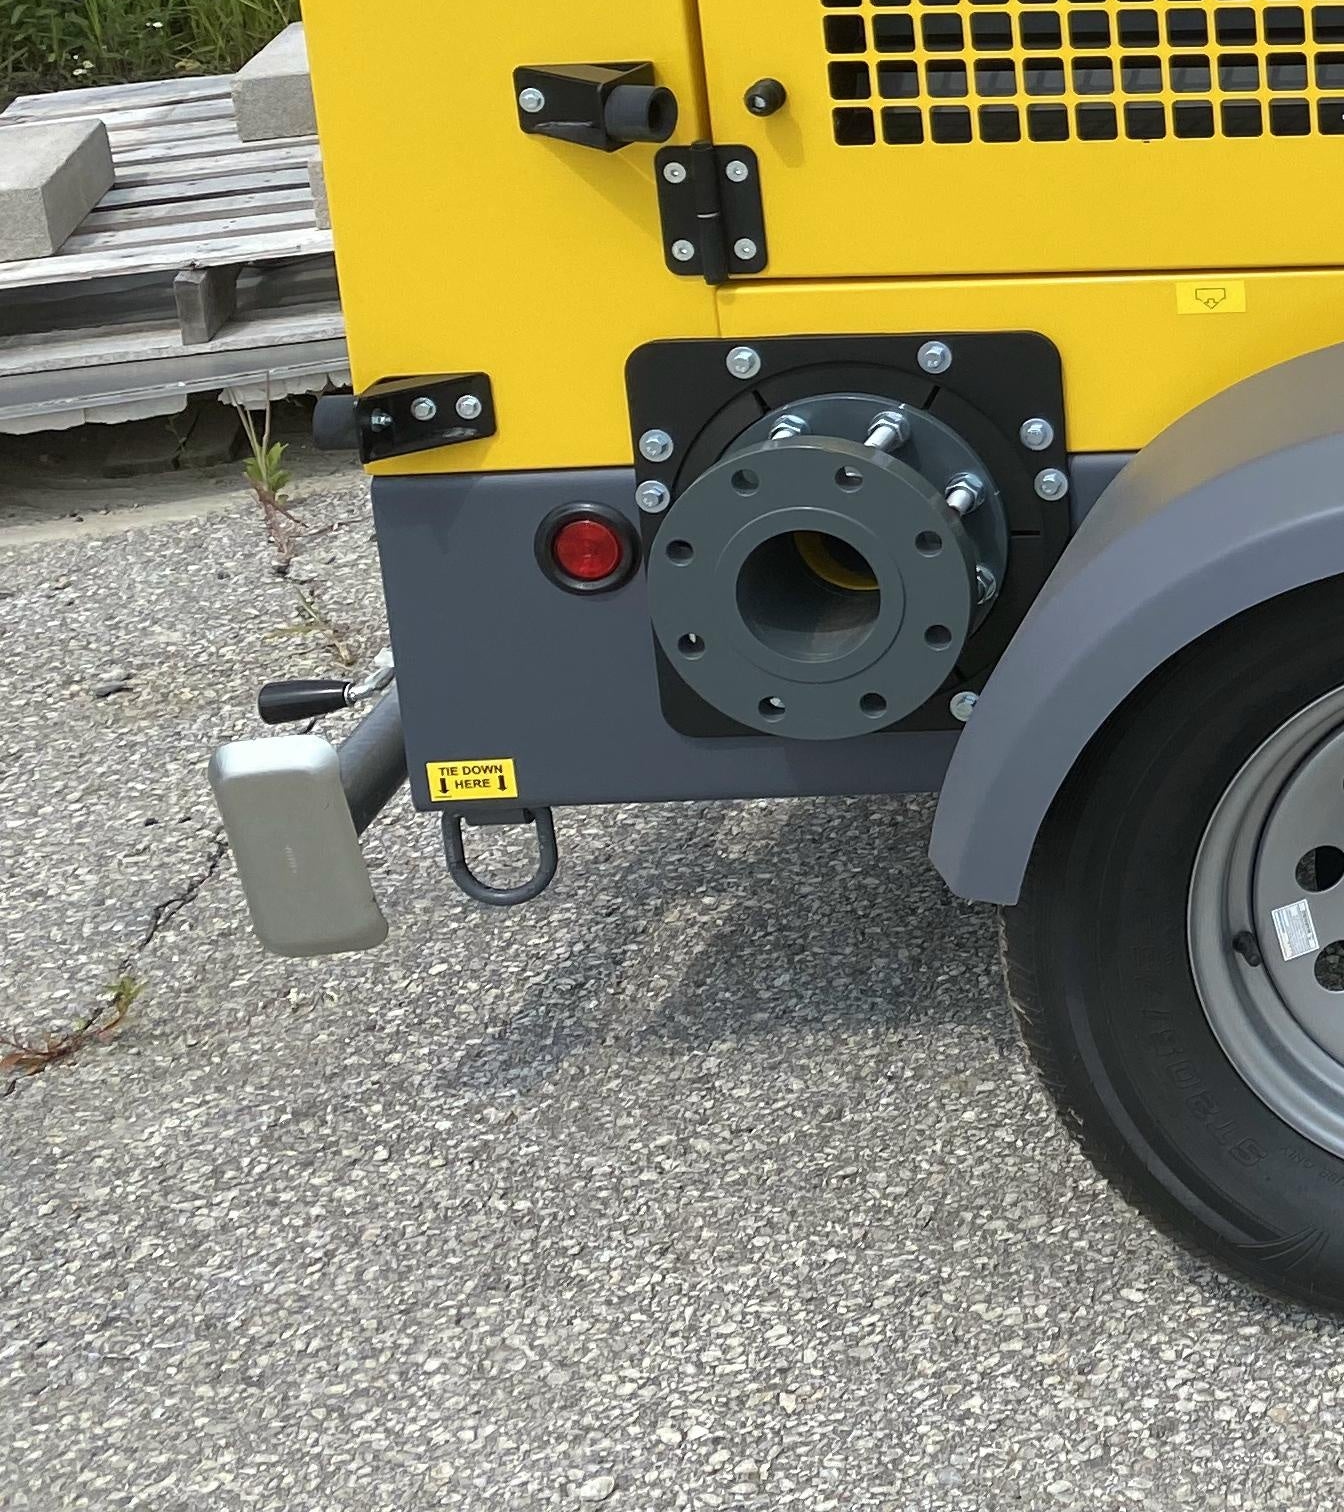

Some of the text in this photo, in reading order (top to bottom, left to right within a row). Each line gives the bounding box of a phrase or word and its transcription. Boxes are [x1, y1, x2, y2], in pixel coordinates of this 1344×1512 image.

[438, 764, 503, 777] TIE DOWN
[454, 778, 491, 790] HERE
